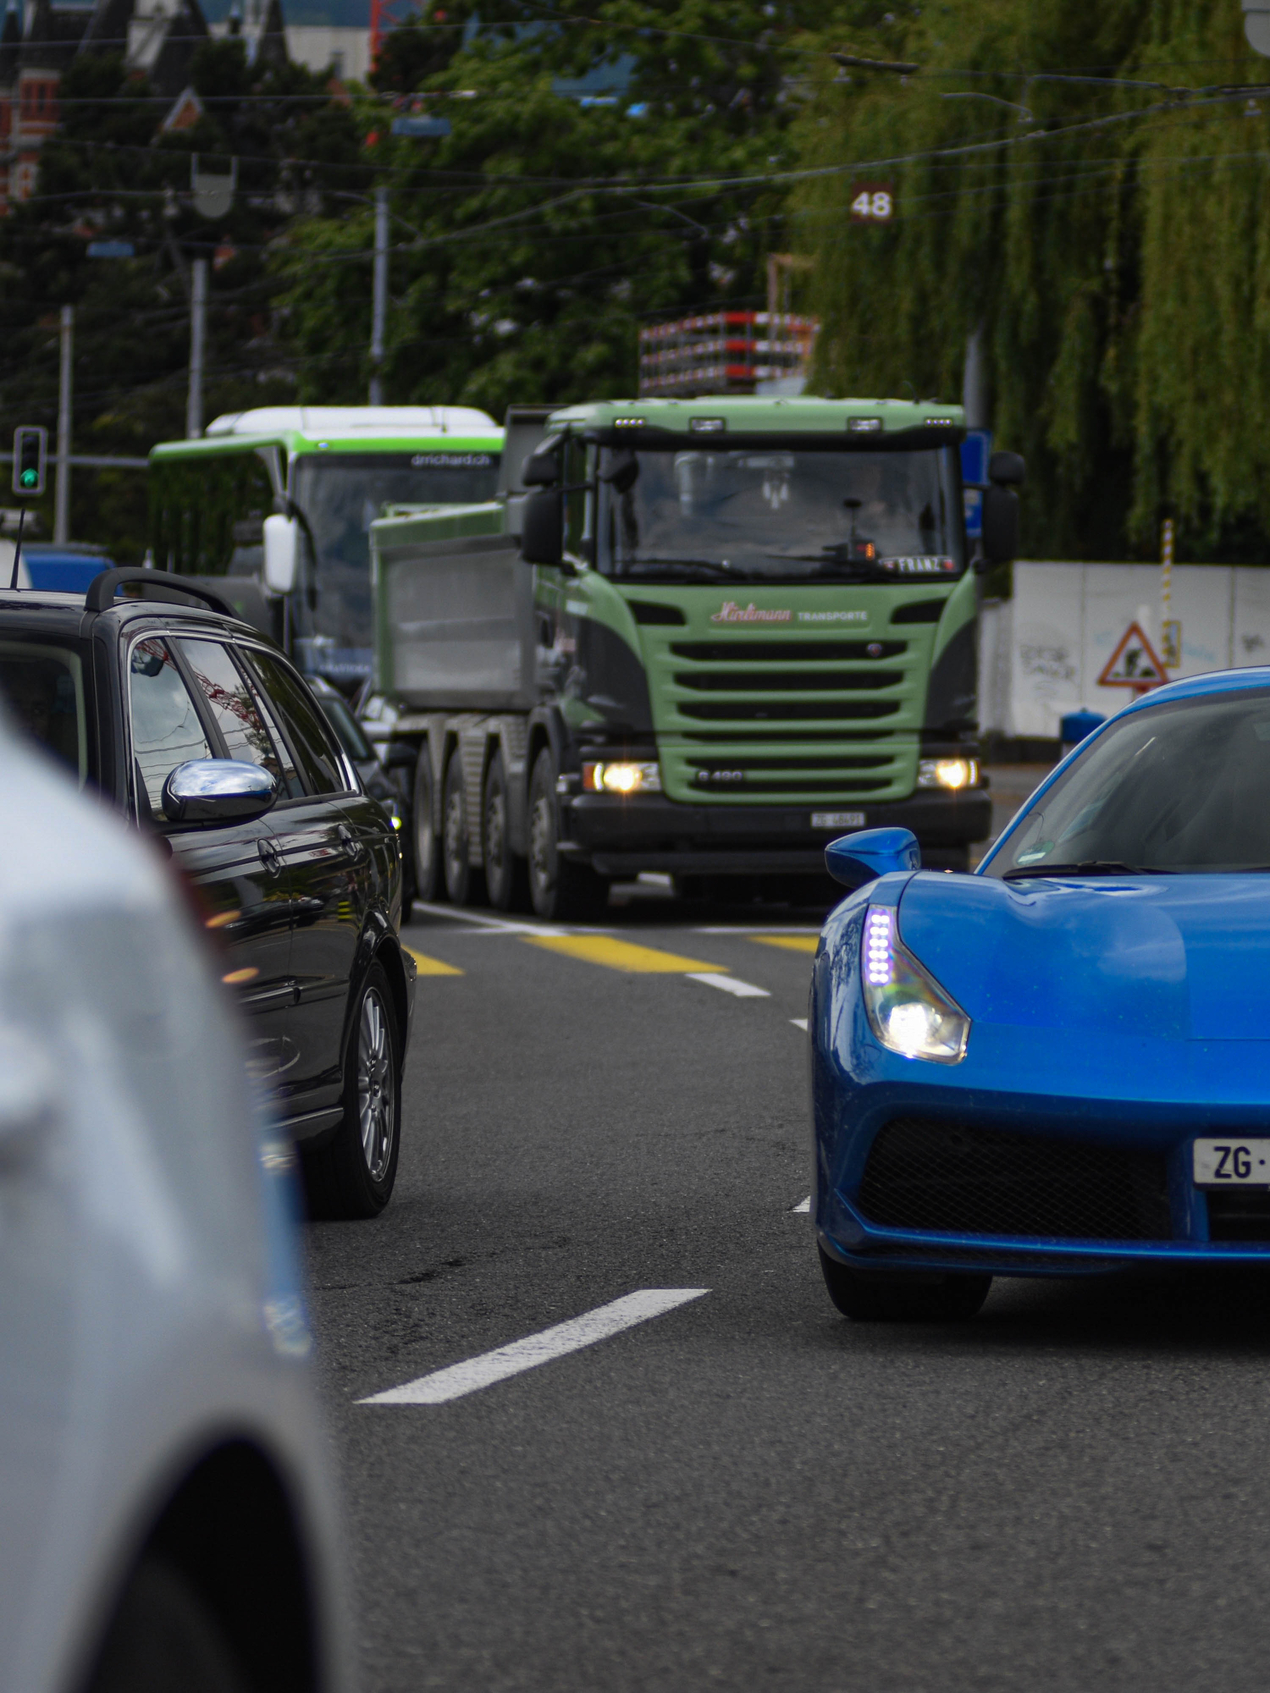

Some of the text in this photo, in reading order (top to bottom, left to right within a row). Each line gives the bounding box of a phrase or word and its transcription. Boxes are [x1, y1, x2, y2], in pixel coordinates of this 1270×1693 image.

[853, 191, 891, 217] 48
[898, 558, 940, 572] FRANZ
[798, 611, 868, 621] TRANSPORTE
[699, 771, 709, 782] G
